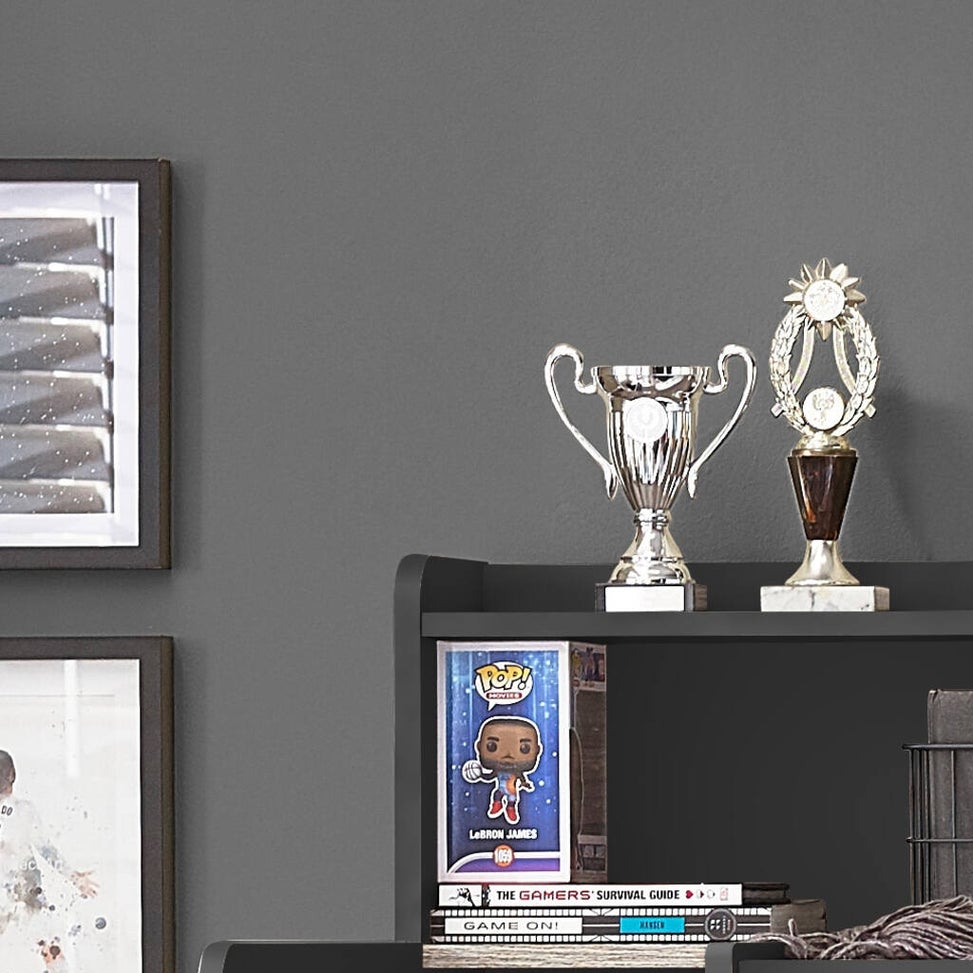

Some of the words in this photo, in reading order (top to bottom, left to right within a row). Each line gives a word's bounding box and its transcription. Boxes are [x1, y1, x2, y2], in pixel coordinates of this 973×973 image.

[475, 664, 532, 693] POP!
[469, 829, 504, 840] LeBRON
[506, 829, 538, 840] JAMES
[496, 890, 516, 900] THE
[596, 890, 646, 900] SURVIVAL
[649, 890, 680, 900] GUIDE
[464, 921, 519, 931] GAME
[526, 921, 559, 931] ON!
